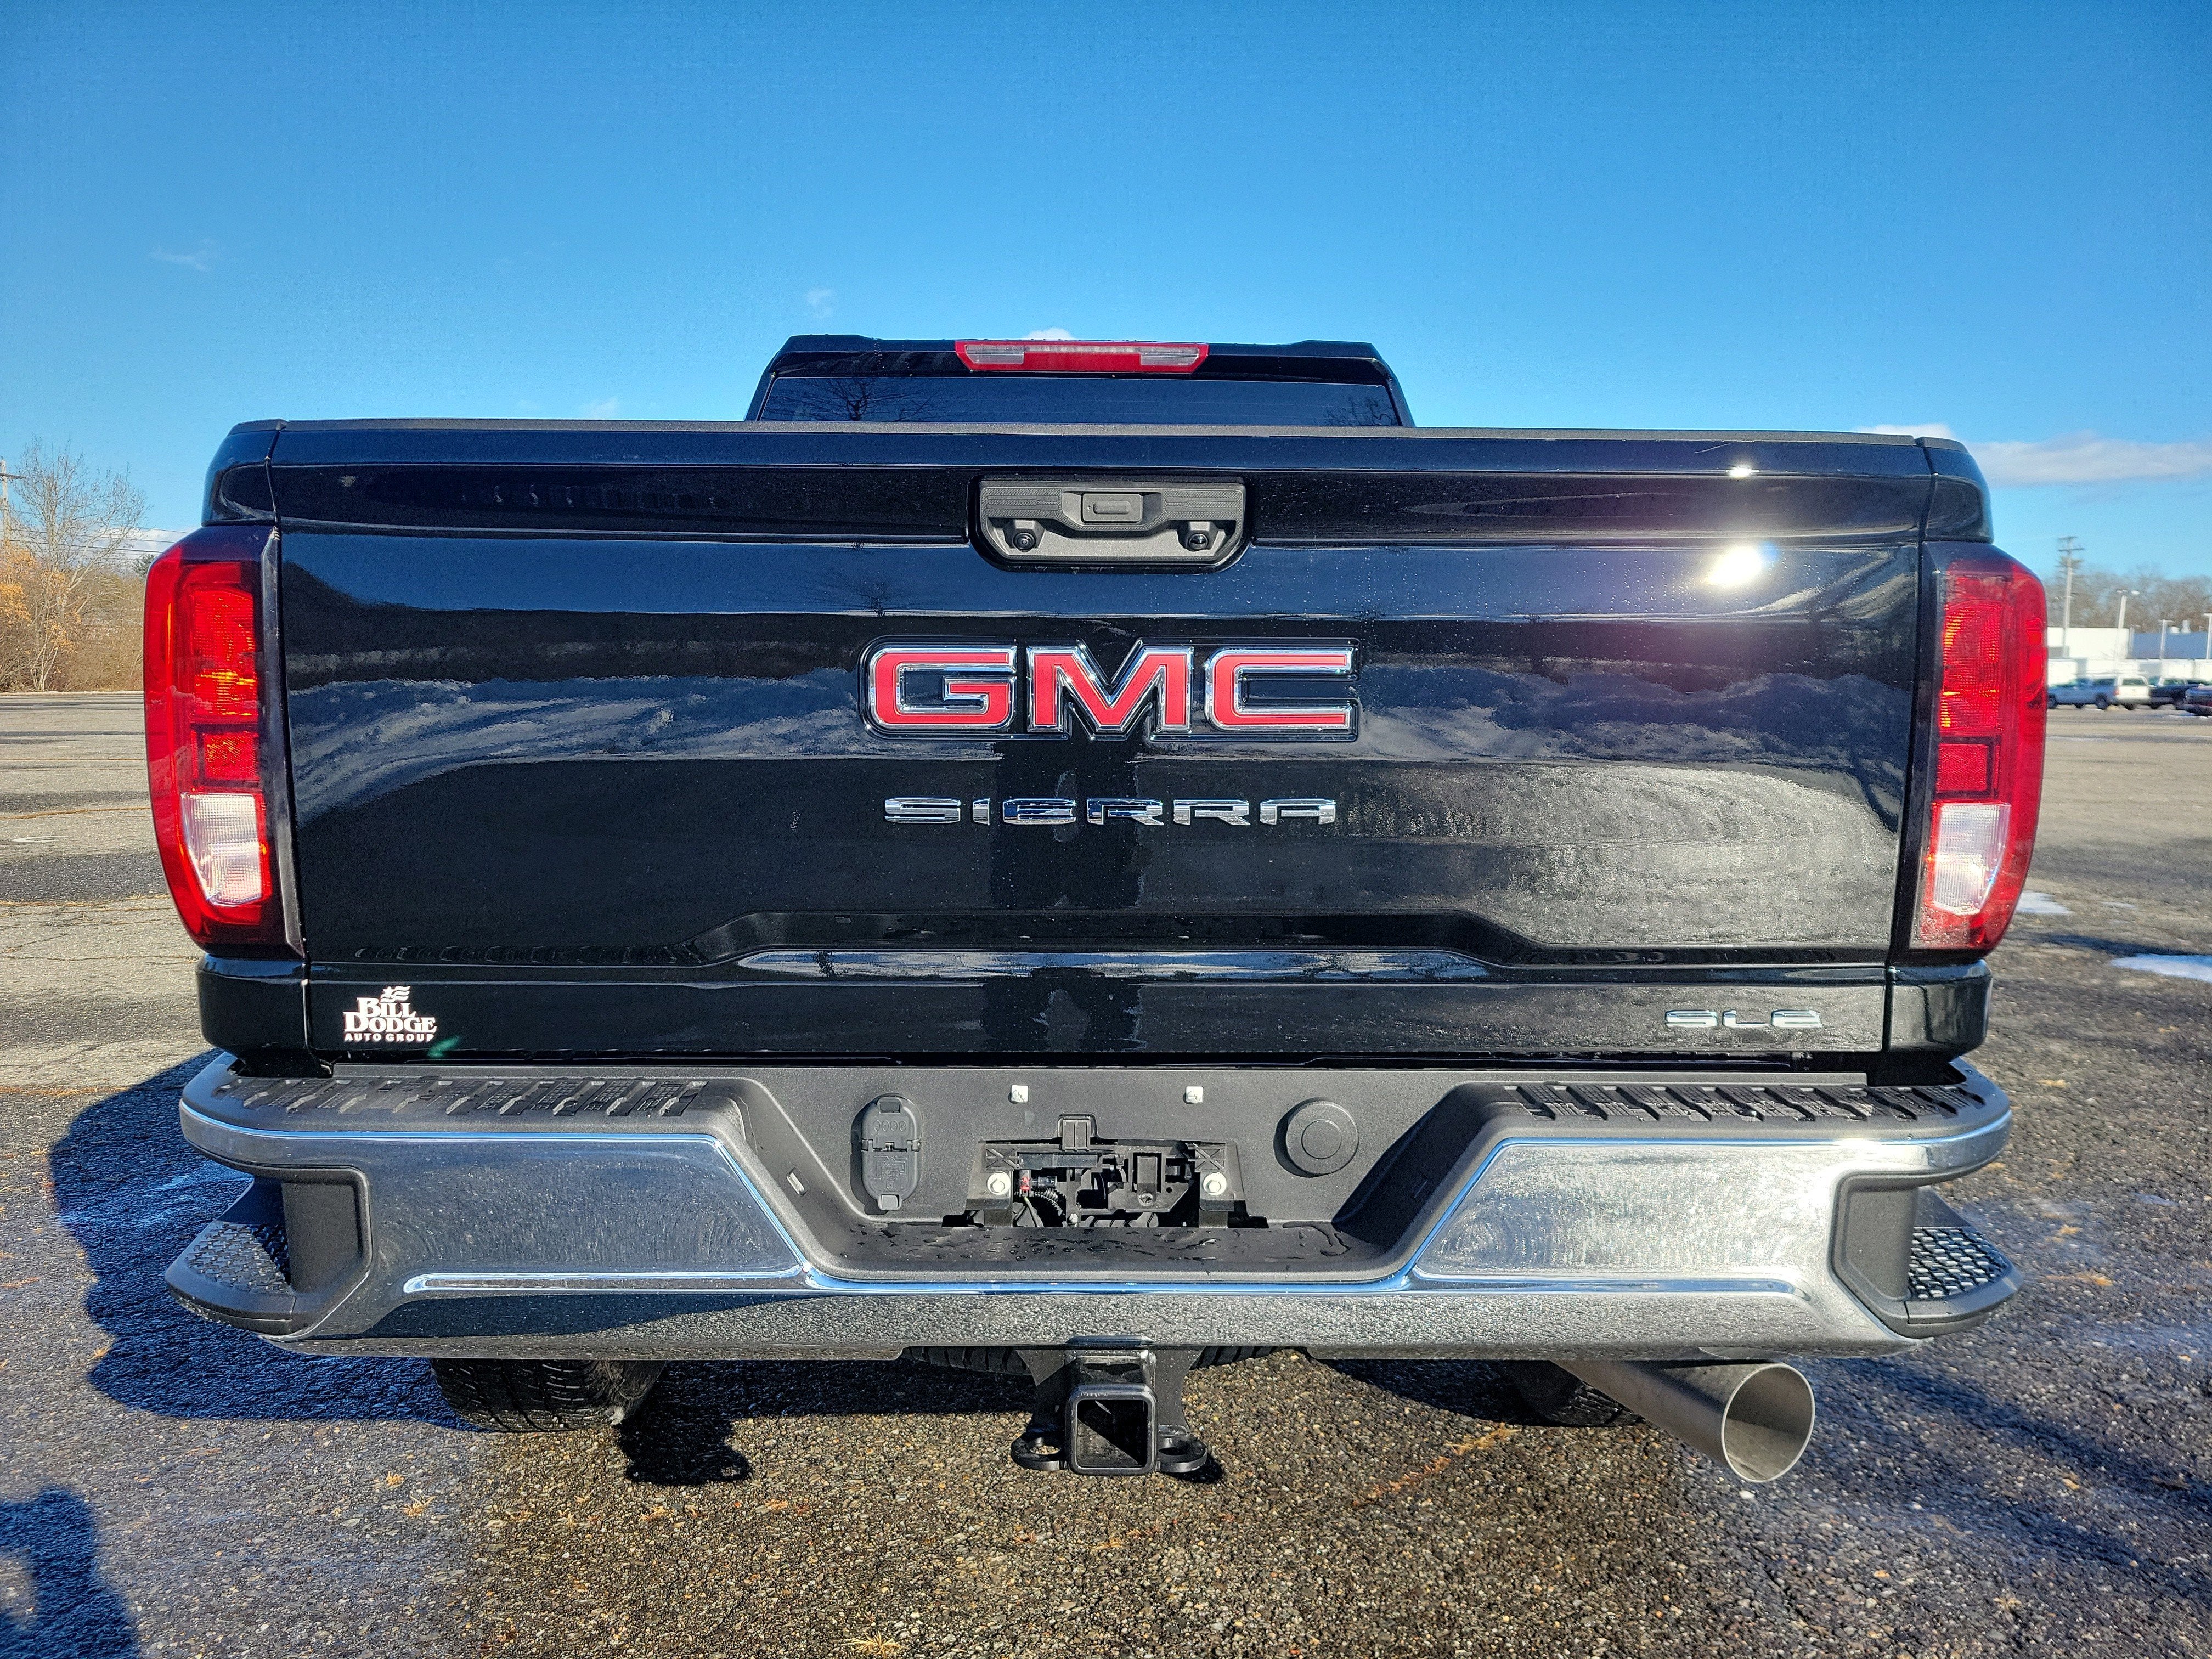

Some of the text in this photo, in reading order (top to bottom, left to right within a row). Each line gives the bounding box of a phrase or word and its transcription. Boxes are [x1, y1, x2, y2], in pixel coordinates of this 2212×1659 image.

[869, 642, 1356, 735] GMC
[884, 797, 1337, 826] SIERRA
[357, 997, 417, 1018] BILL
[343, 1011, 438, 1033] DODGE
[1664, 1009, 1822, 1028] SLE
[344, 1032, 435, 1042] AUTO GROUP
